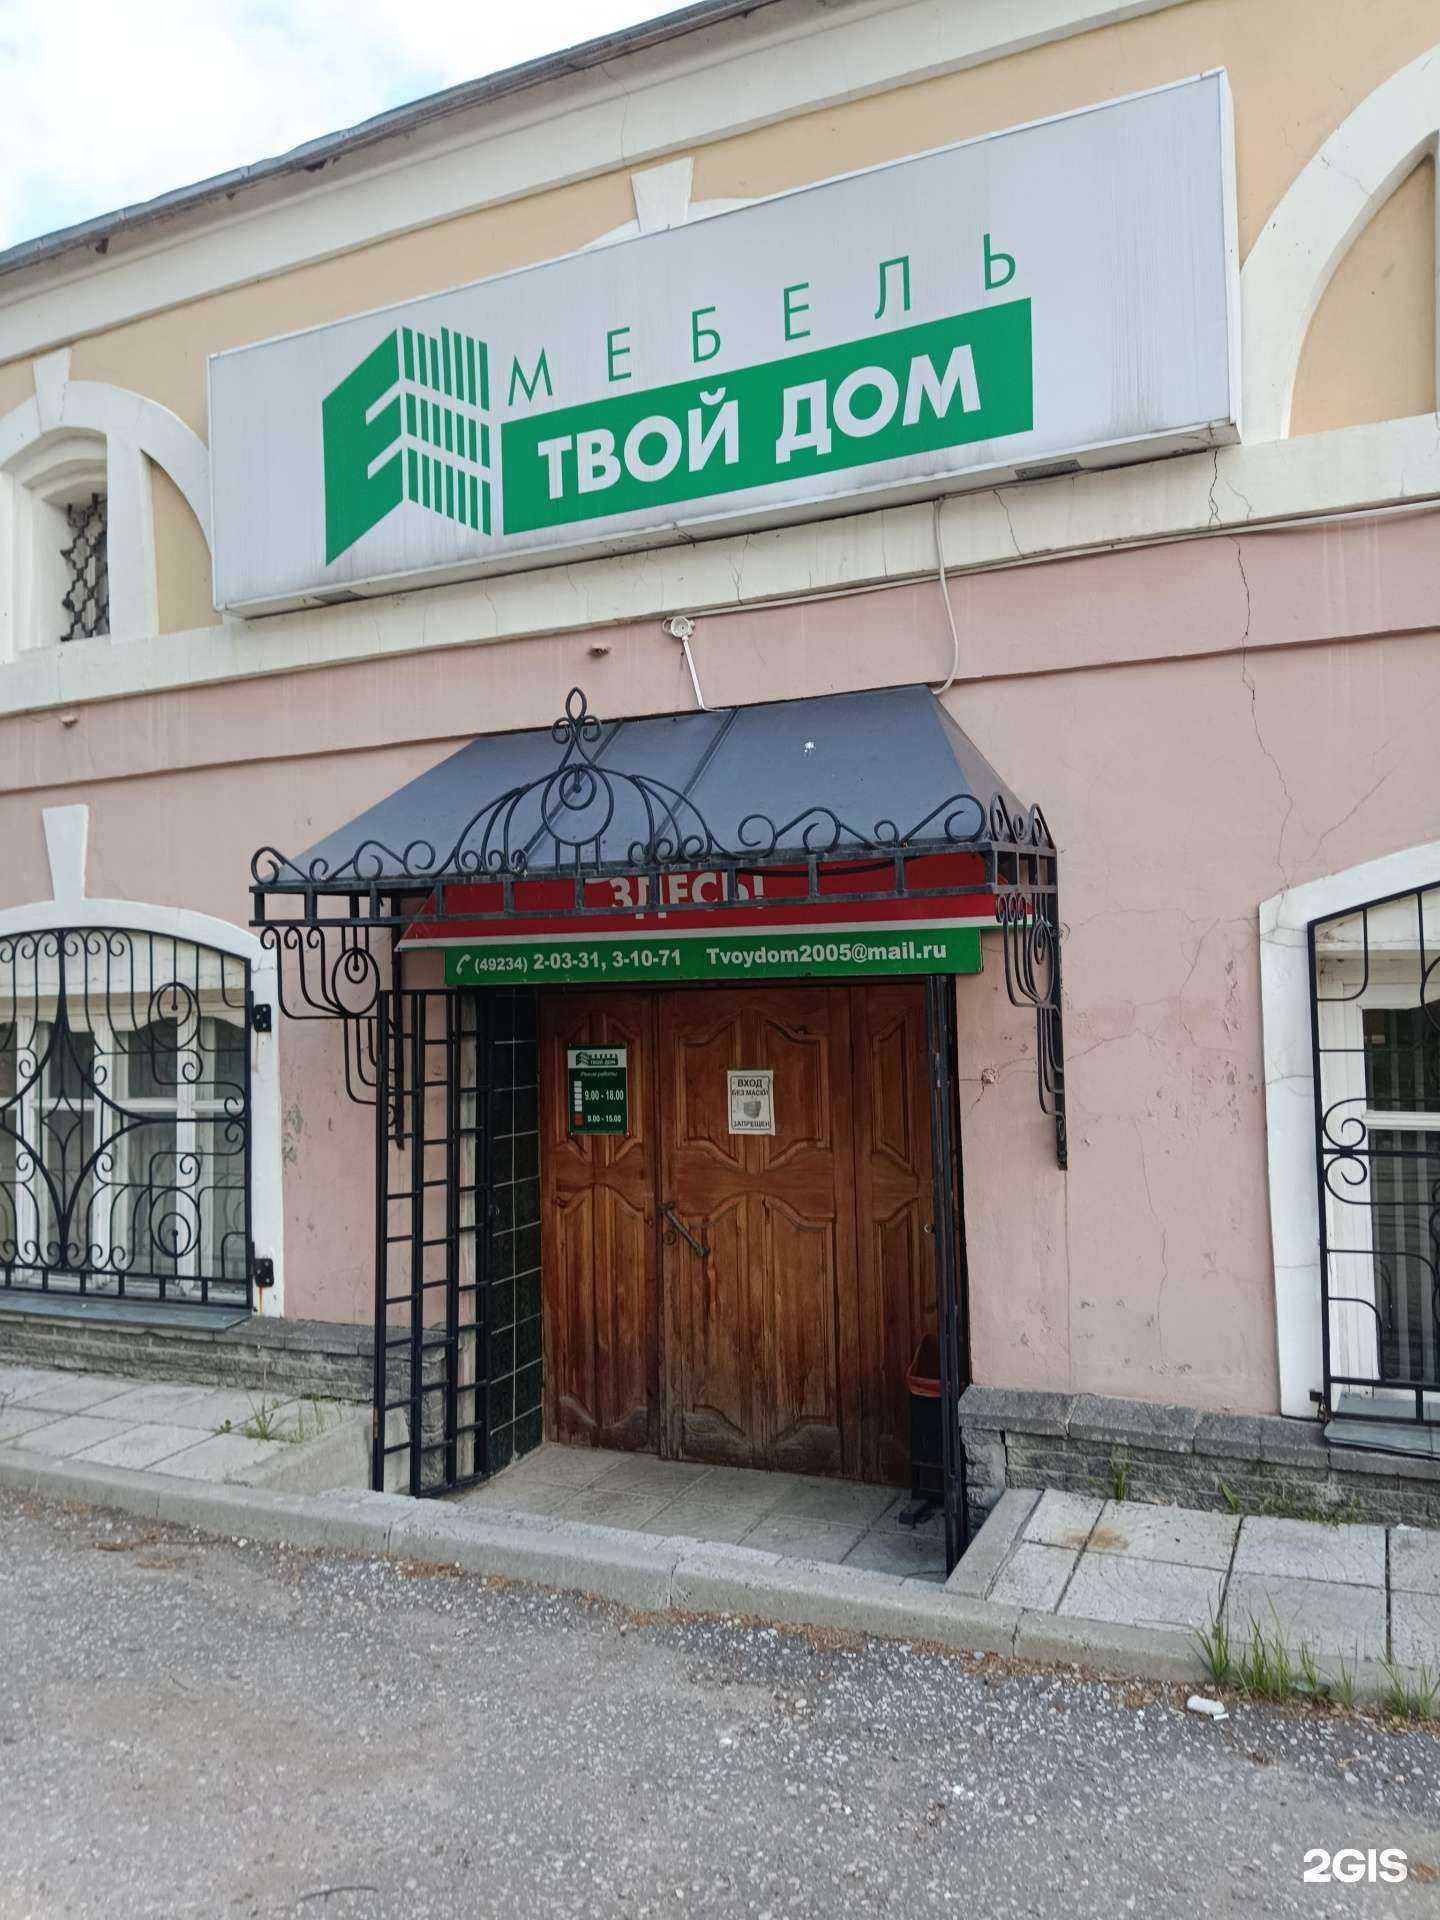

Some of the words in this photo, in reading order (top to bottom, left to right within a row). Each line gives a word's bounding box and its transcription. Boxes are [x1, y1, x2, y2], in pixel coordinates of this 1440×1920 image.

[507, 233, 1017, 407] МЕБЕЛЬ
[537, 387, 741, 500] ТВОЙ
[775, 344, 982, 464] ДОМ
[475, 956, 528, 973] (49234)
[533, 952, 607, 971] 2-03-31,
[612, 949, 681, 967] 3-10-71
[706, 941, 947, 968] Tvoydom2005@mail.ru
[584, 1089, 600, 1101] 9.00
[605, 1089, 624, 1101] 18.00
[737, 1078, 763, 1088] ВХОД
